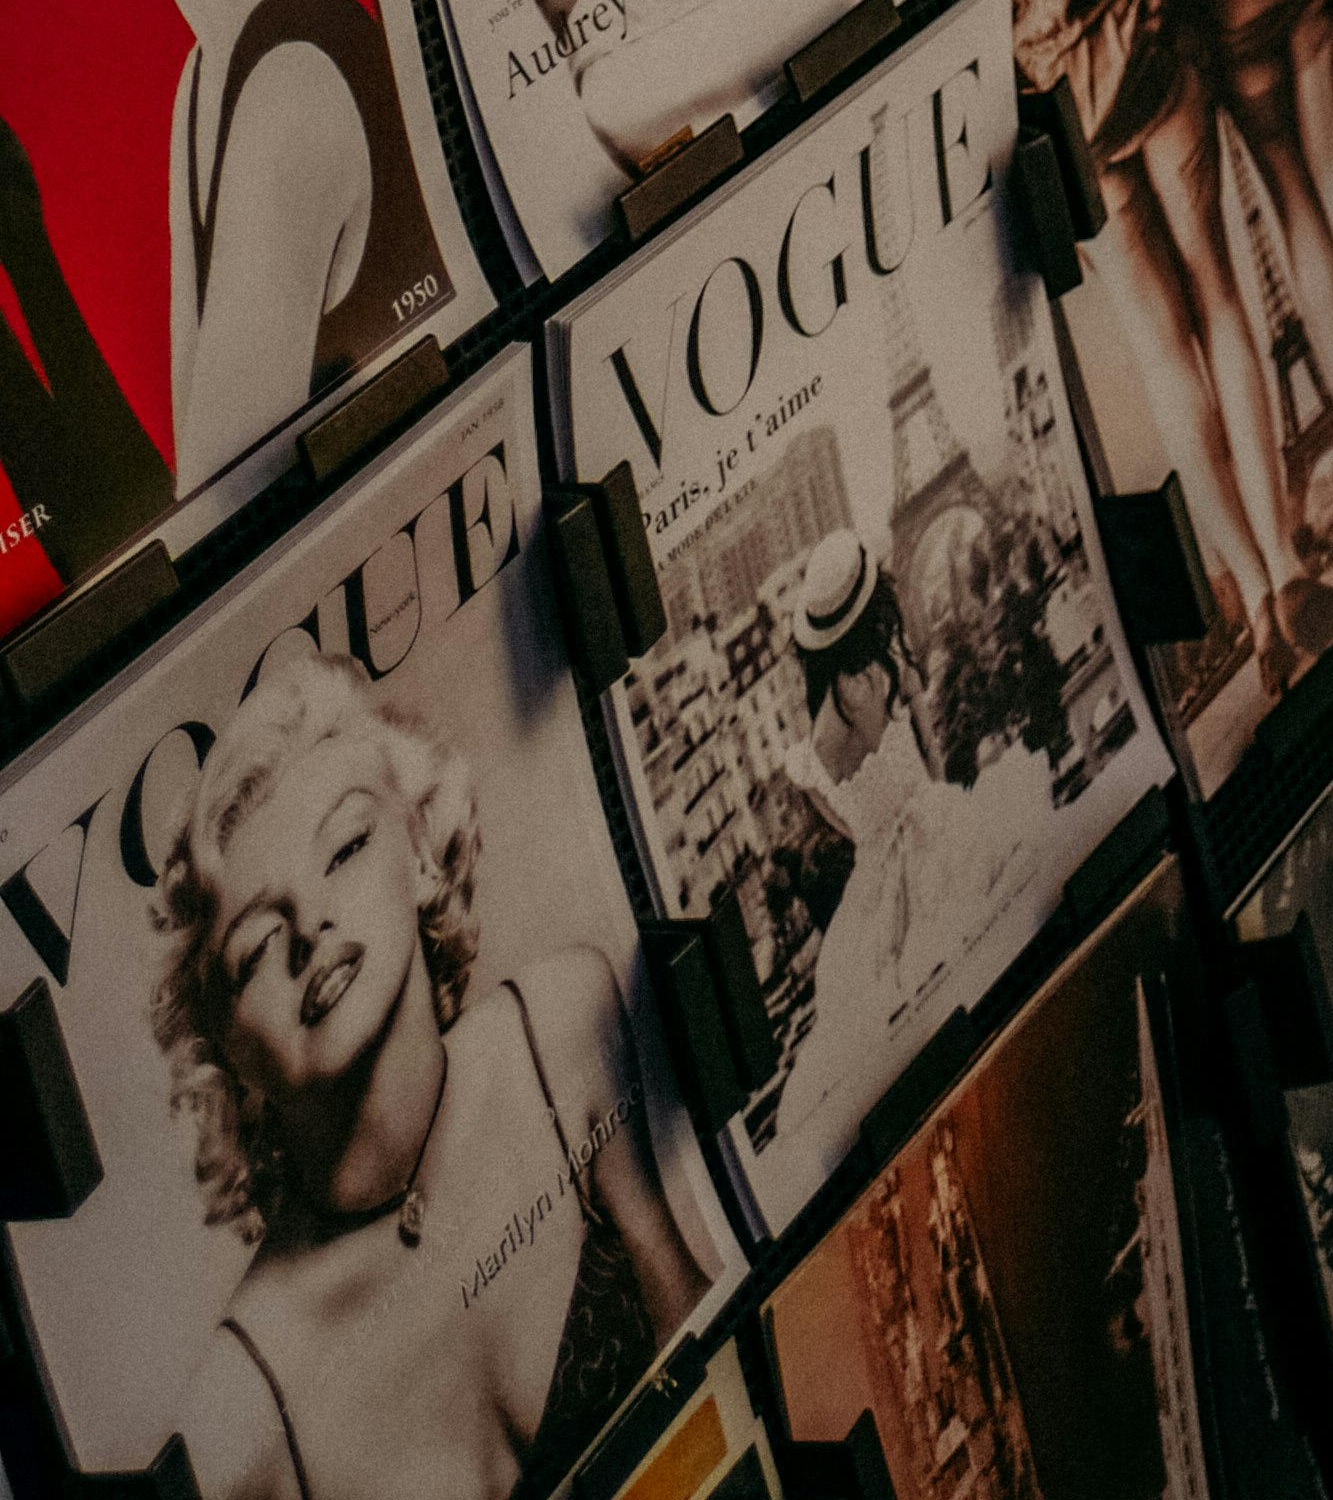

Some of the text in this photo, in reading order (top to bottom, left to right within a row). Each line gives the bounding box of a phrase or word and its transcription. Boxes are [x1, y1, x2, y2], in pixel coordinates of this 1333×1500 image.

[391, 274, 439, 321] 1950
[600, 60, 994, 472] VOGUE
[716, 449, 740, 493] je
[459, 1083, 643, 1309] Marilyn Monroe
